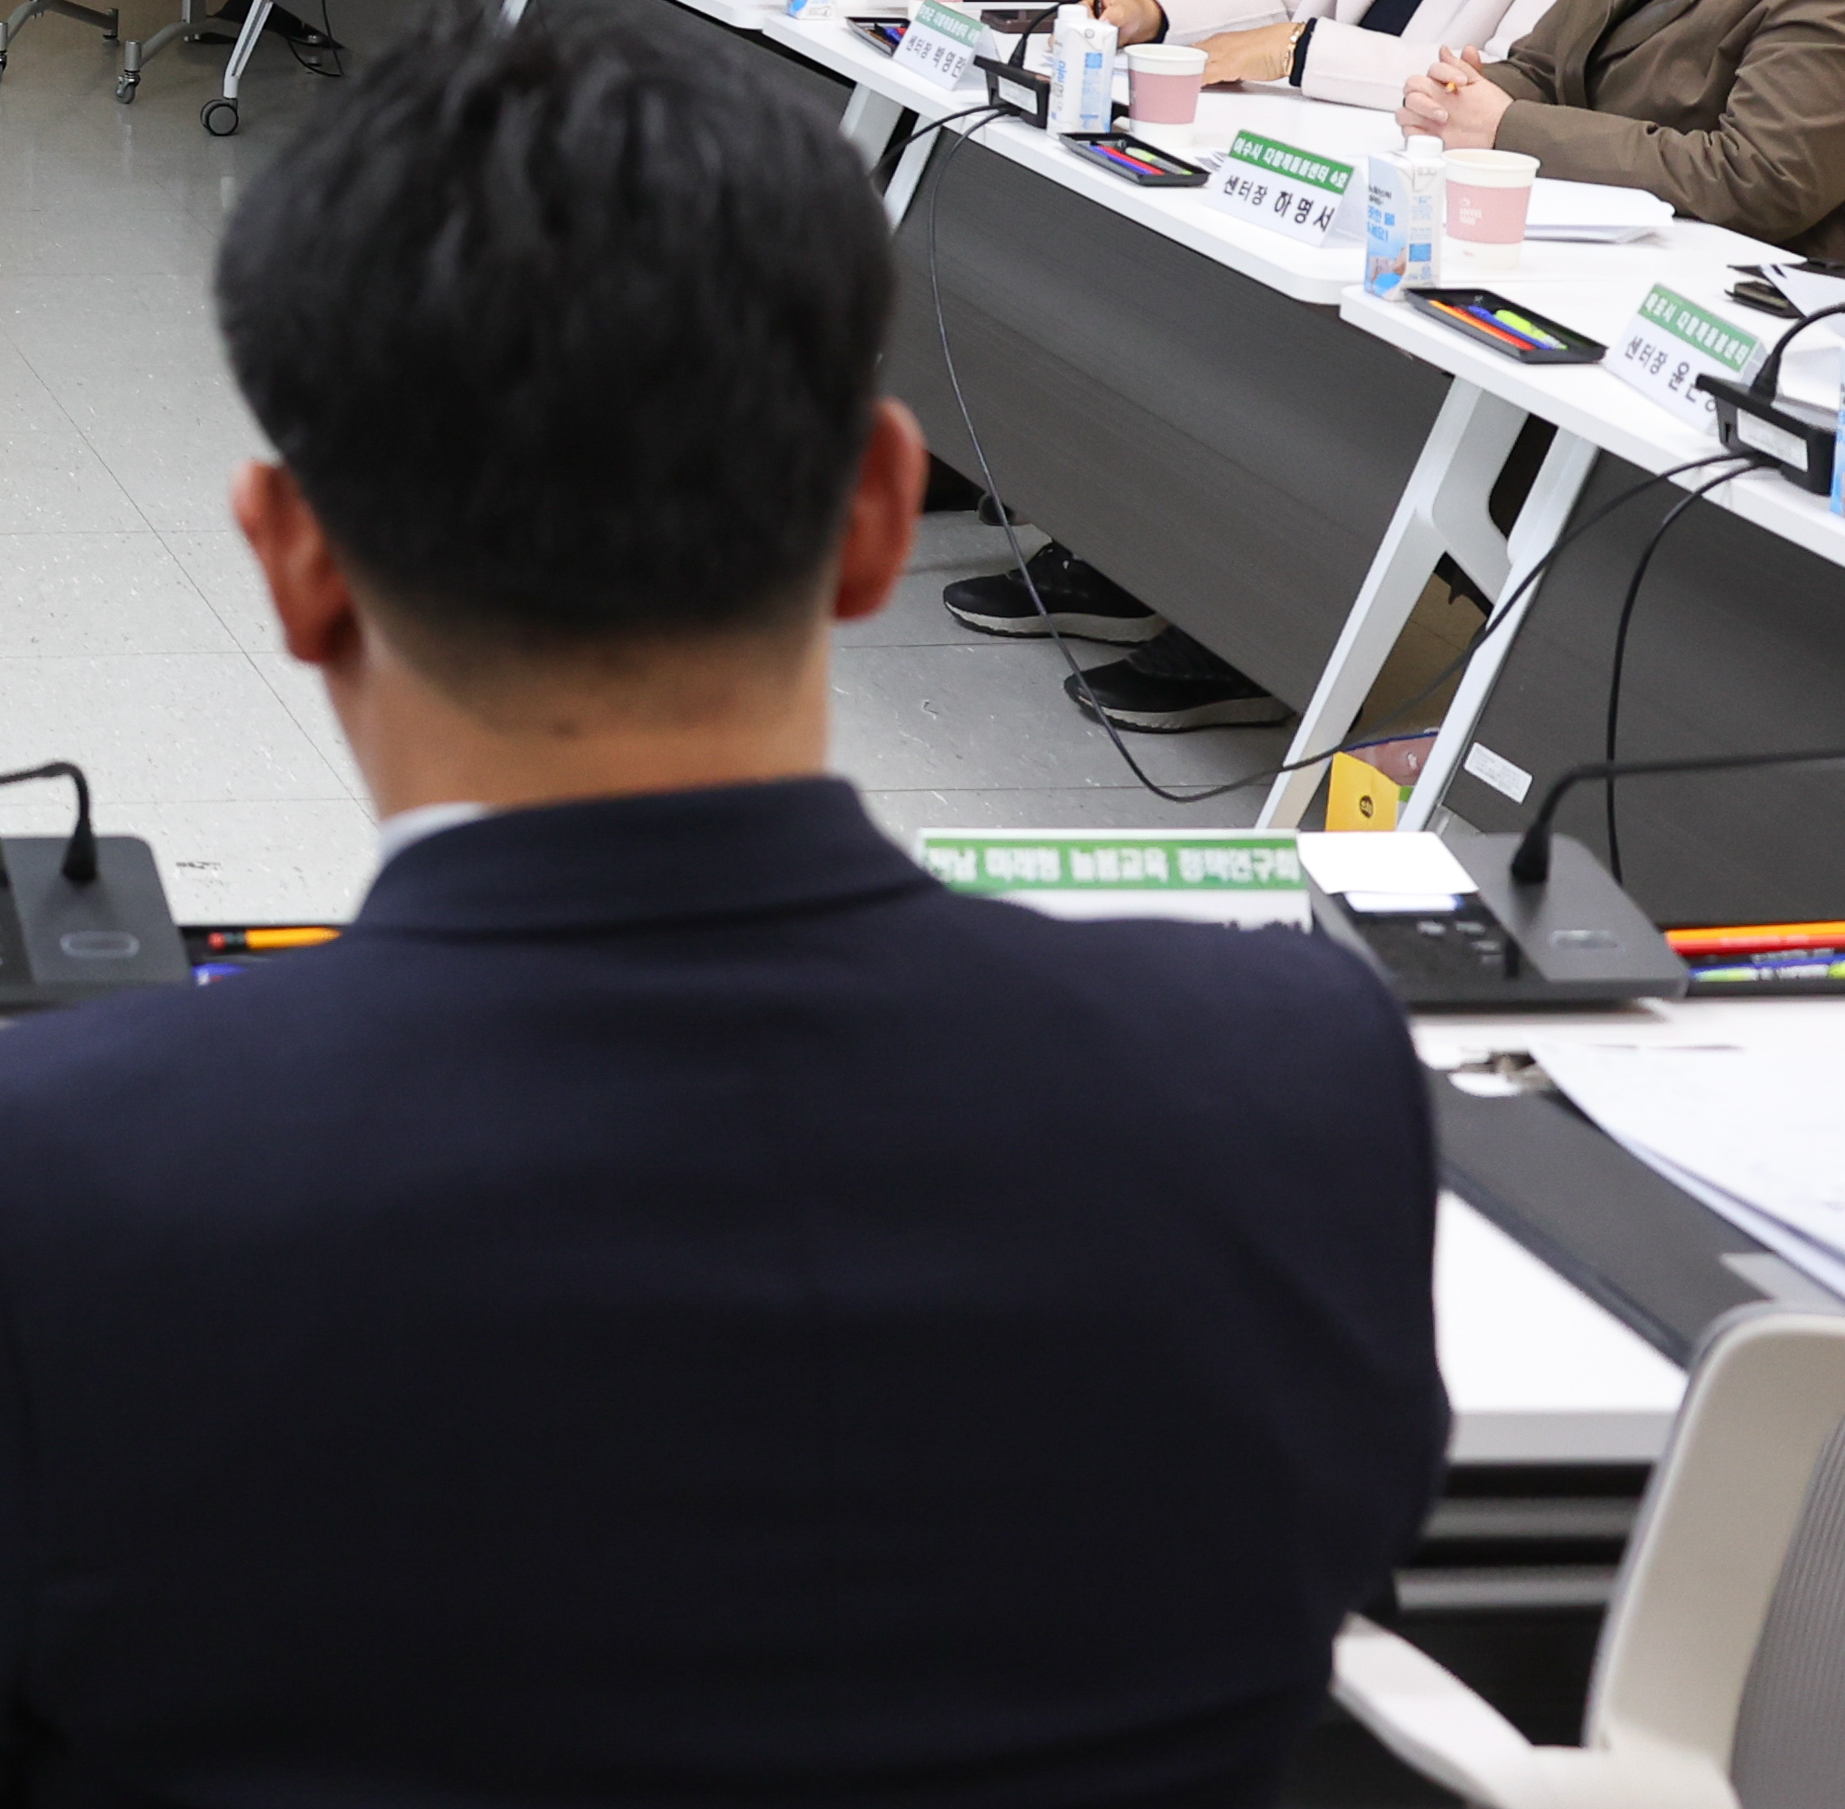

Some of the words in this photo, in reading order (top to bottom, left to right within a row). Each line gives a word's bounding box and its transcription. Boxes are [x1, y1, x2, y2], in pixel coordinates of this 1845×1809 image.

[1233, 135, 1265, 161] 여수시
[1223, 176, 1269, 207] 센터장
[1273, 190, 1333, 233] 하명서
[1624, 335, 1669, 375] 센터장
[984, 844, 1062, 881] 미래형
[1069, 844, 1170, 882] 늘봄교육
